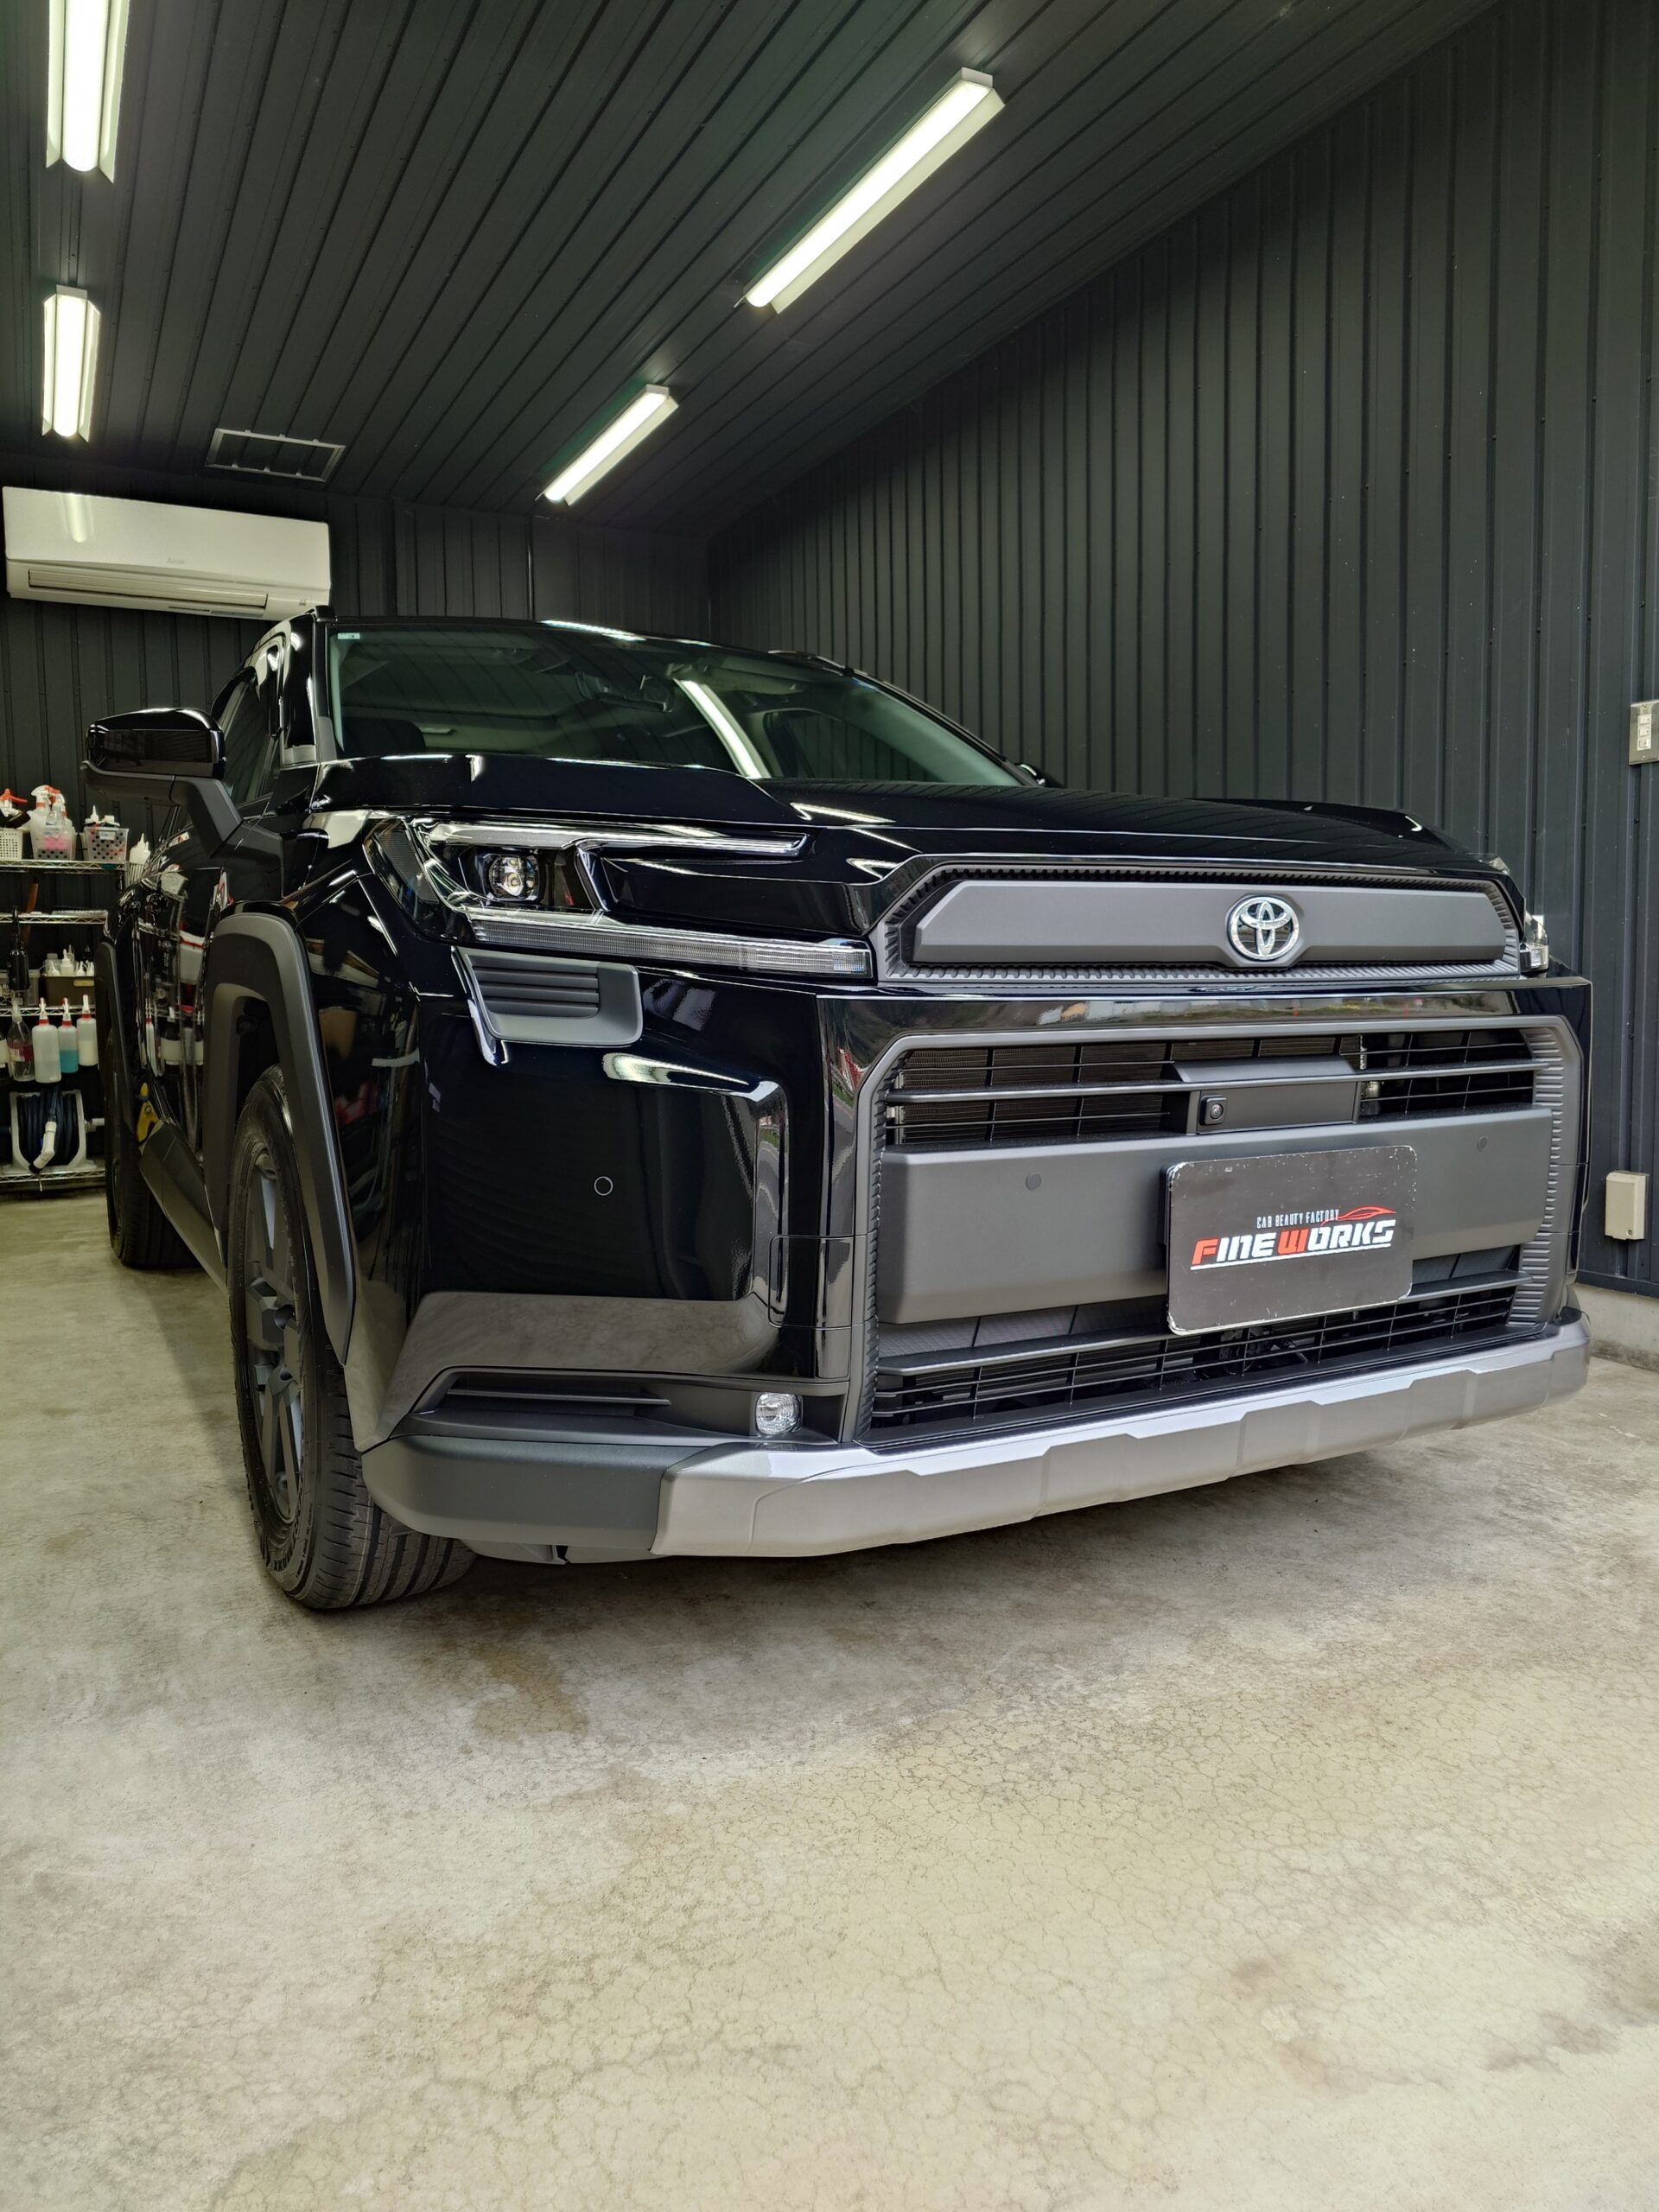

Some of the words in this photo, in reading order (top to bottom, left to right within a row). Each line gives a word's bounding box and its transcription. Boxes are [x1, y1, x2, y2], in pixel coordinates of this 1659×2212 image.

[1256, 1215, 1272, 1229] CAR
[1274, 1212, 1304, 1227] BEAUTY
[1306, 1209, 1339, 1224] FACTORY
